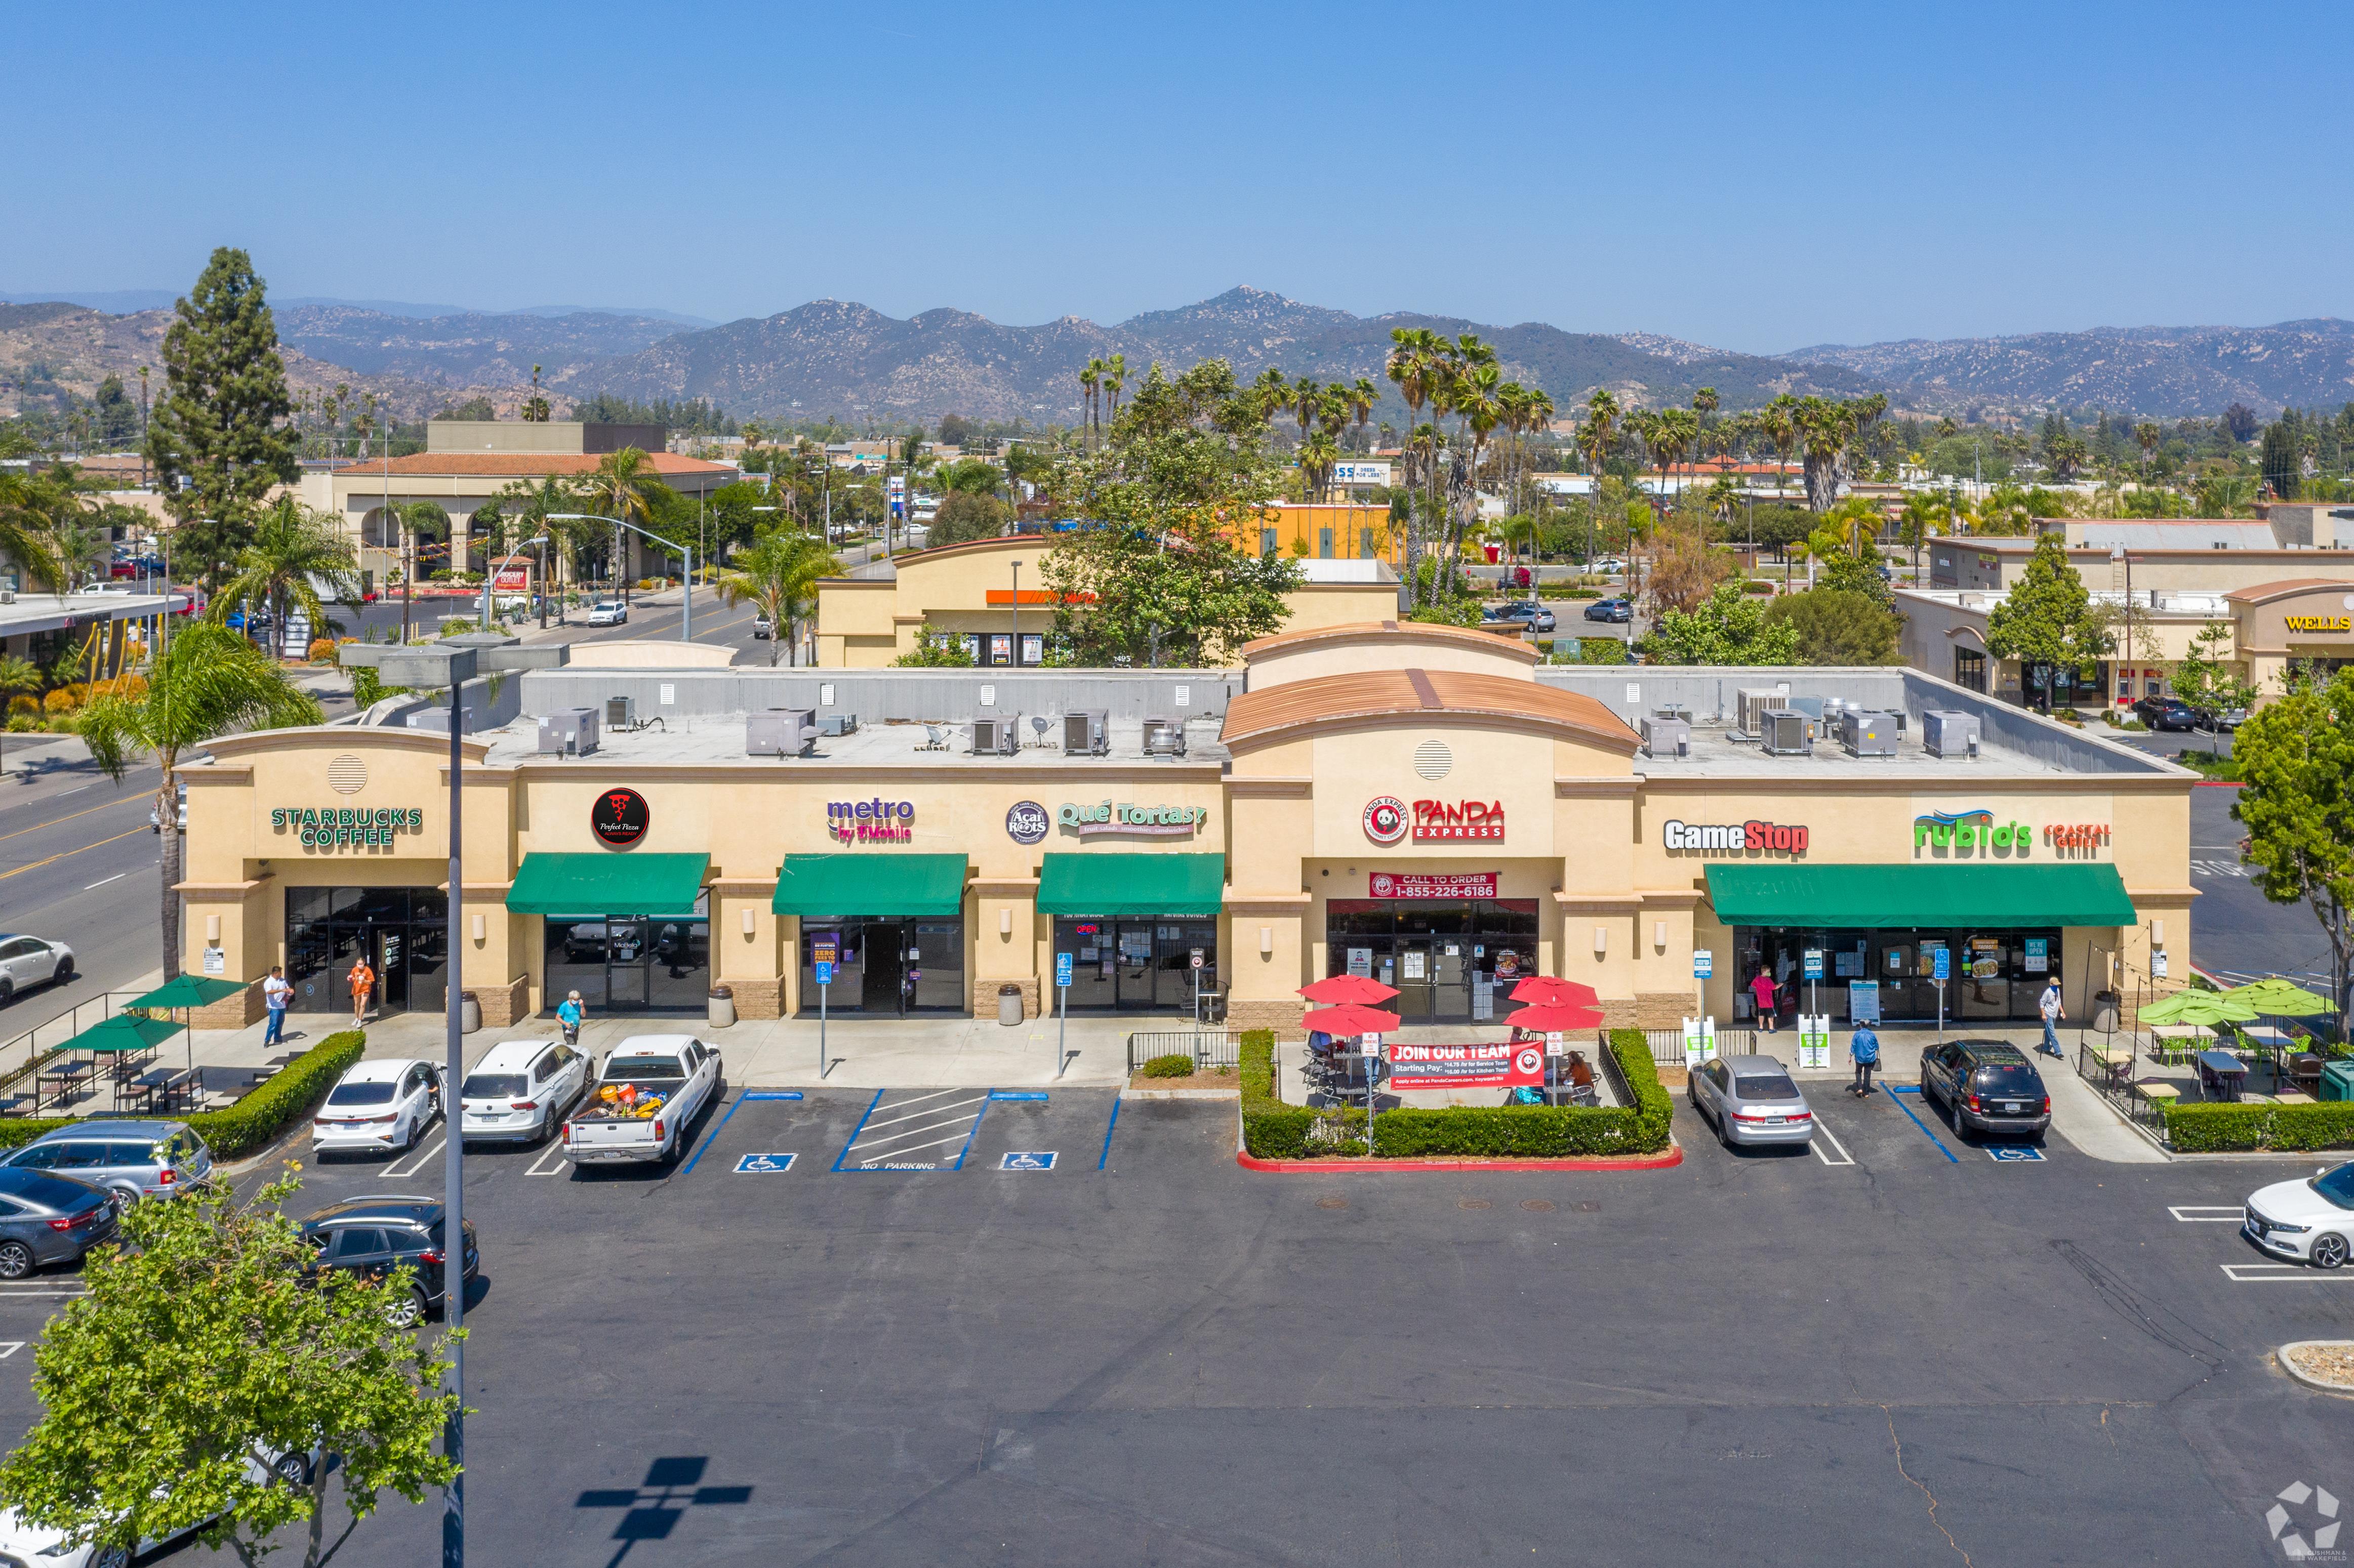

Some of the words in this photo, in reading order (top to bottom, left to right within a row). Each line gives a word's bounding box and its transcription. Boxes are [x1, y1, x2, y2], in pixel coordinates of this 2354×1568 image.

[2285, 616, 2351, 630] WELLS
[827, 798, 914, 819] metro
[1057, 799, 1112, 827] Qué
[1365, 800, 1383, 819] PANDA
[1385, 798, 1407, 820] EXPRESS
[1412, 799, 1505, 826] PANDA
[271, 808, 422, 827] STARBUCKS
[600, 822, 621, 831] Perfect
[838, 826, 855, 842] by
[1368, 827, 1386, 839] GOURMET
[1387, 828, 1403, 839] CHINESE
[1416, 828, 1500, 837] EXPRESS
[1915, 815, 2033, 847] rubio's
[2044, 824, 2112, 835] COASTAL
[300, 828, 393, 846] COFFEE
[1664, 819, 1809, 854] GameStop
[2056, 836, 2098, 848] GRILL
[1403, 876, 1430, 884] CALL
[1433, 876, 1447, 884] TO
[1450, 875, 1486, 883] ORDER
[1396, 886, 1493, 897] 1-855-226-6186
[1394, 1046, 1430, 1060] JOIN
[1433, 1045, 1466, 1060] OUR
[1469, 1044, 1511, 1059] TEAM
[1395, 1064, 1425, 1072] Starting
[1427, 1064, 1443, 1072] Pay:
